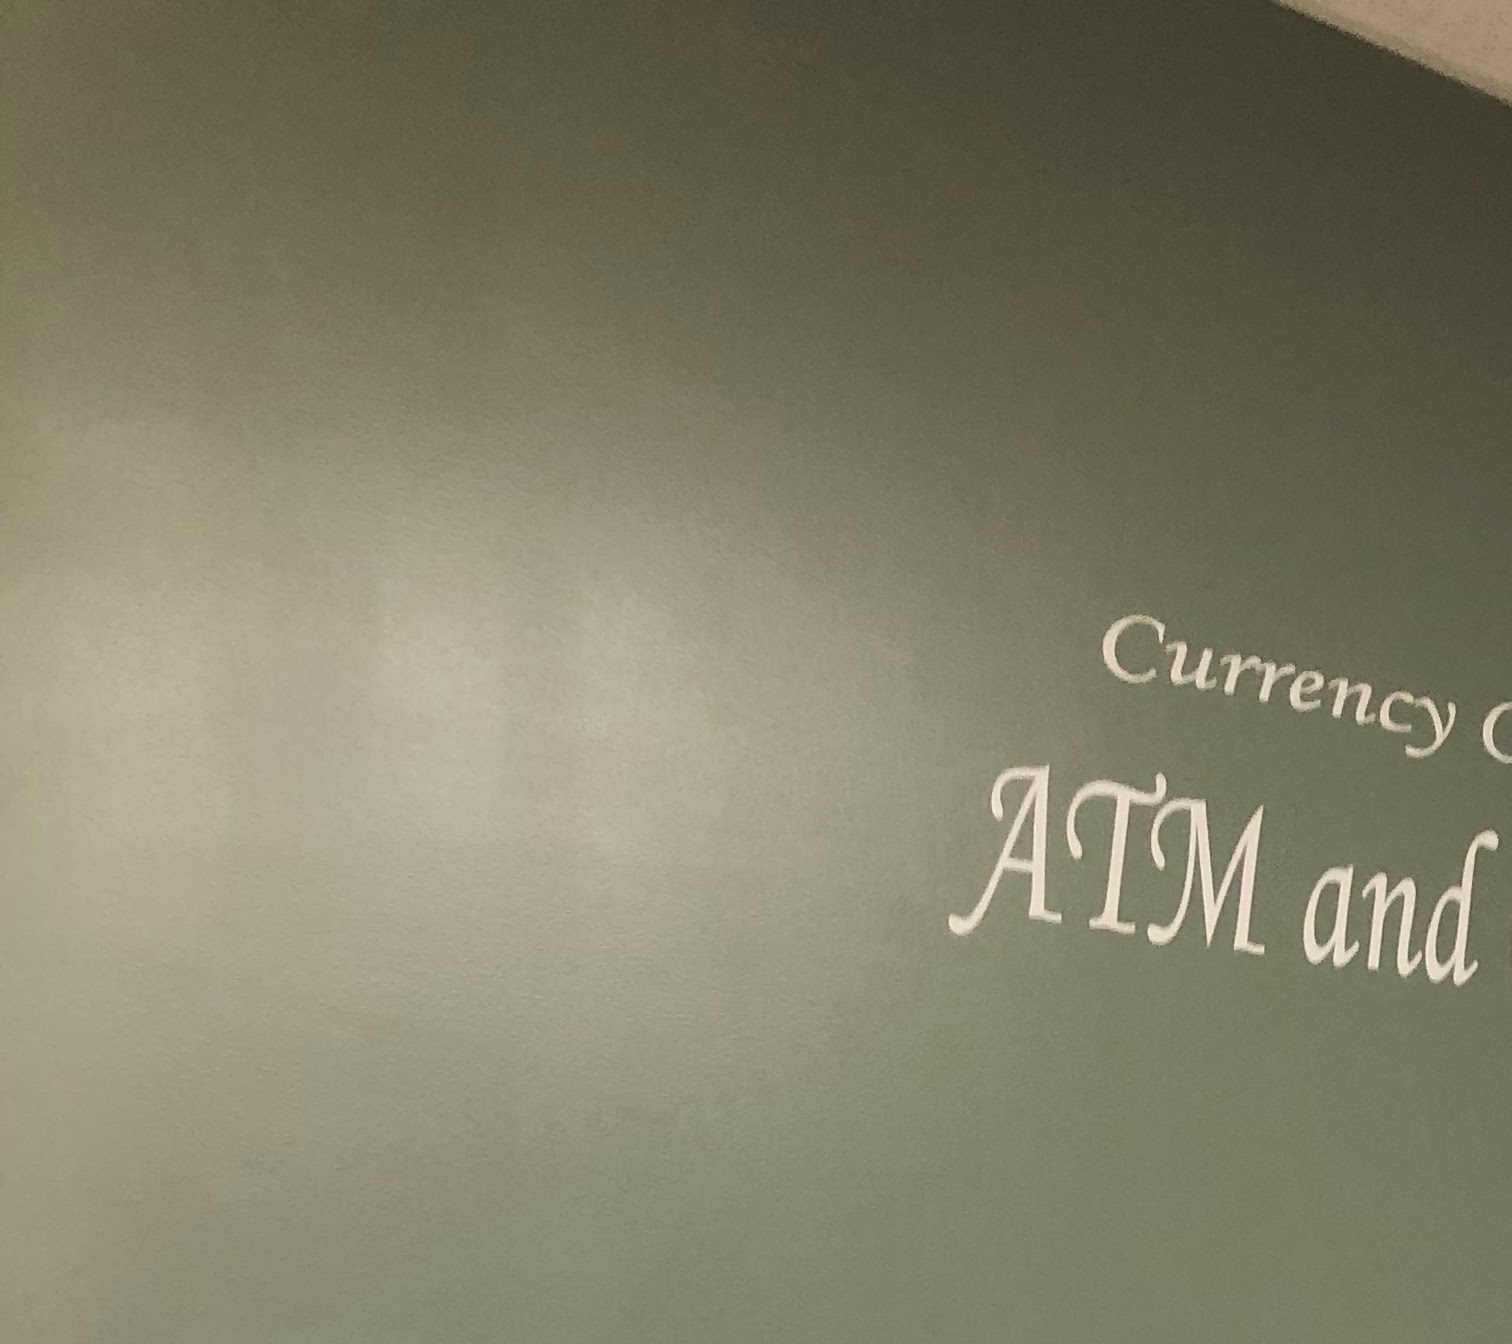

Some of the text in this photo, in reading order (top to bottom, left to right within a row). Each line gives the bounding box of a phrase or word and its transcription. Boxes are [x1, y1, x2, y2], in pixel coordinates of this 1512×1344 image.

[1101, 614, 1457, 757] Currency
[948, 763, 1266, 956] ATM
[1303, 829, 1499, 986] and
